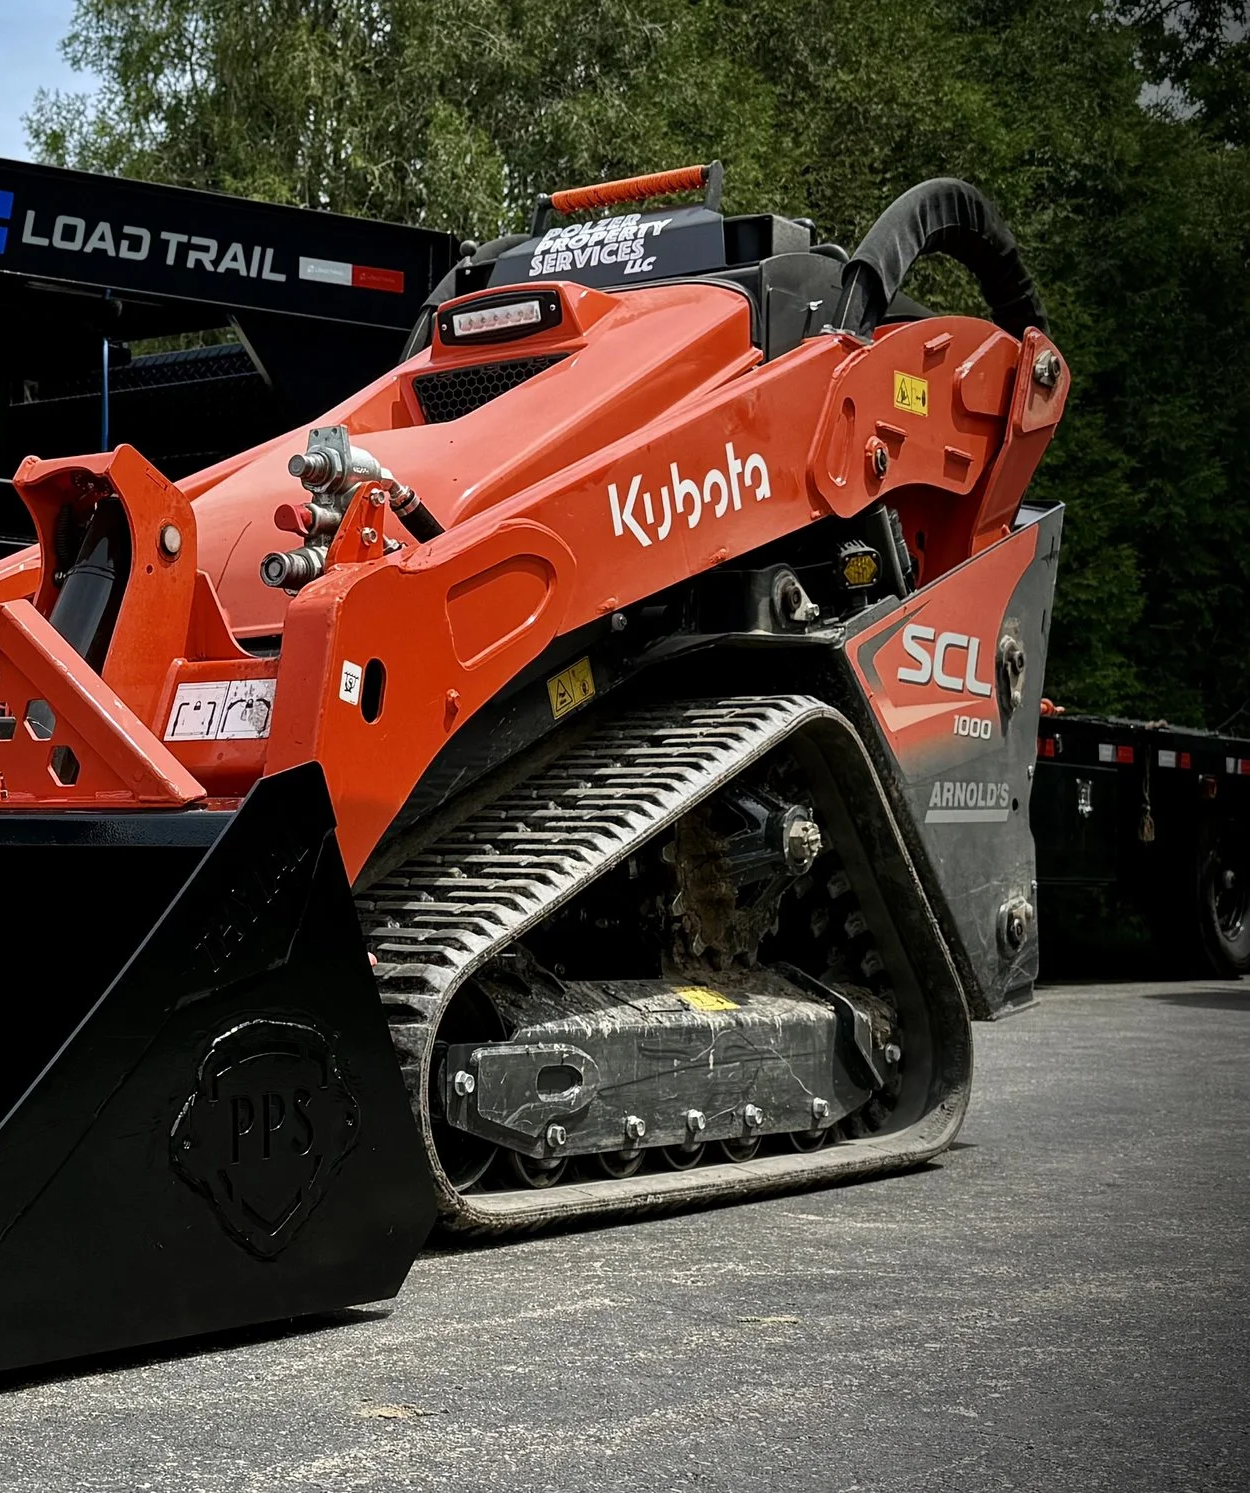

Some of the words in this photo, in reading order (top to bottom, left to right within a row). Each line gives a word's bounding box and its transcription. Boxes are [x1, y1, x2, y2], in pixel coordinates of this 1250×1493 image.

[21, 209, 151, 262] LOAD
[160, 231, 287, 282] TRAIL
[533, 218, 673, 255] PROPERTY
[541, 213, 641, 241] POLZER
[528, 238, 645, 276] SERVICES
[624, 256, 657, 275] LLC
[607, 441, 772, 547] Kubota
[897, 623, 992, 697] SCL
[953, 714, 992, 740] 1000
[929, 781, 1010, 807] ARNOLD'S
[230, 1088, 314, 1165] PPS
